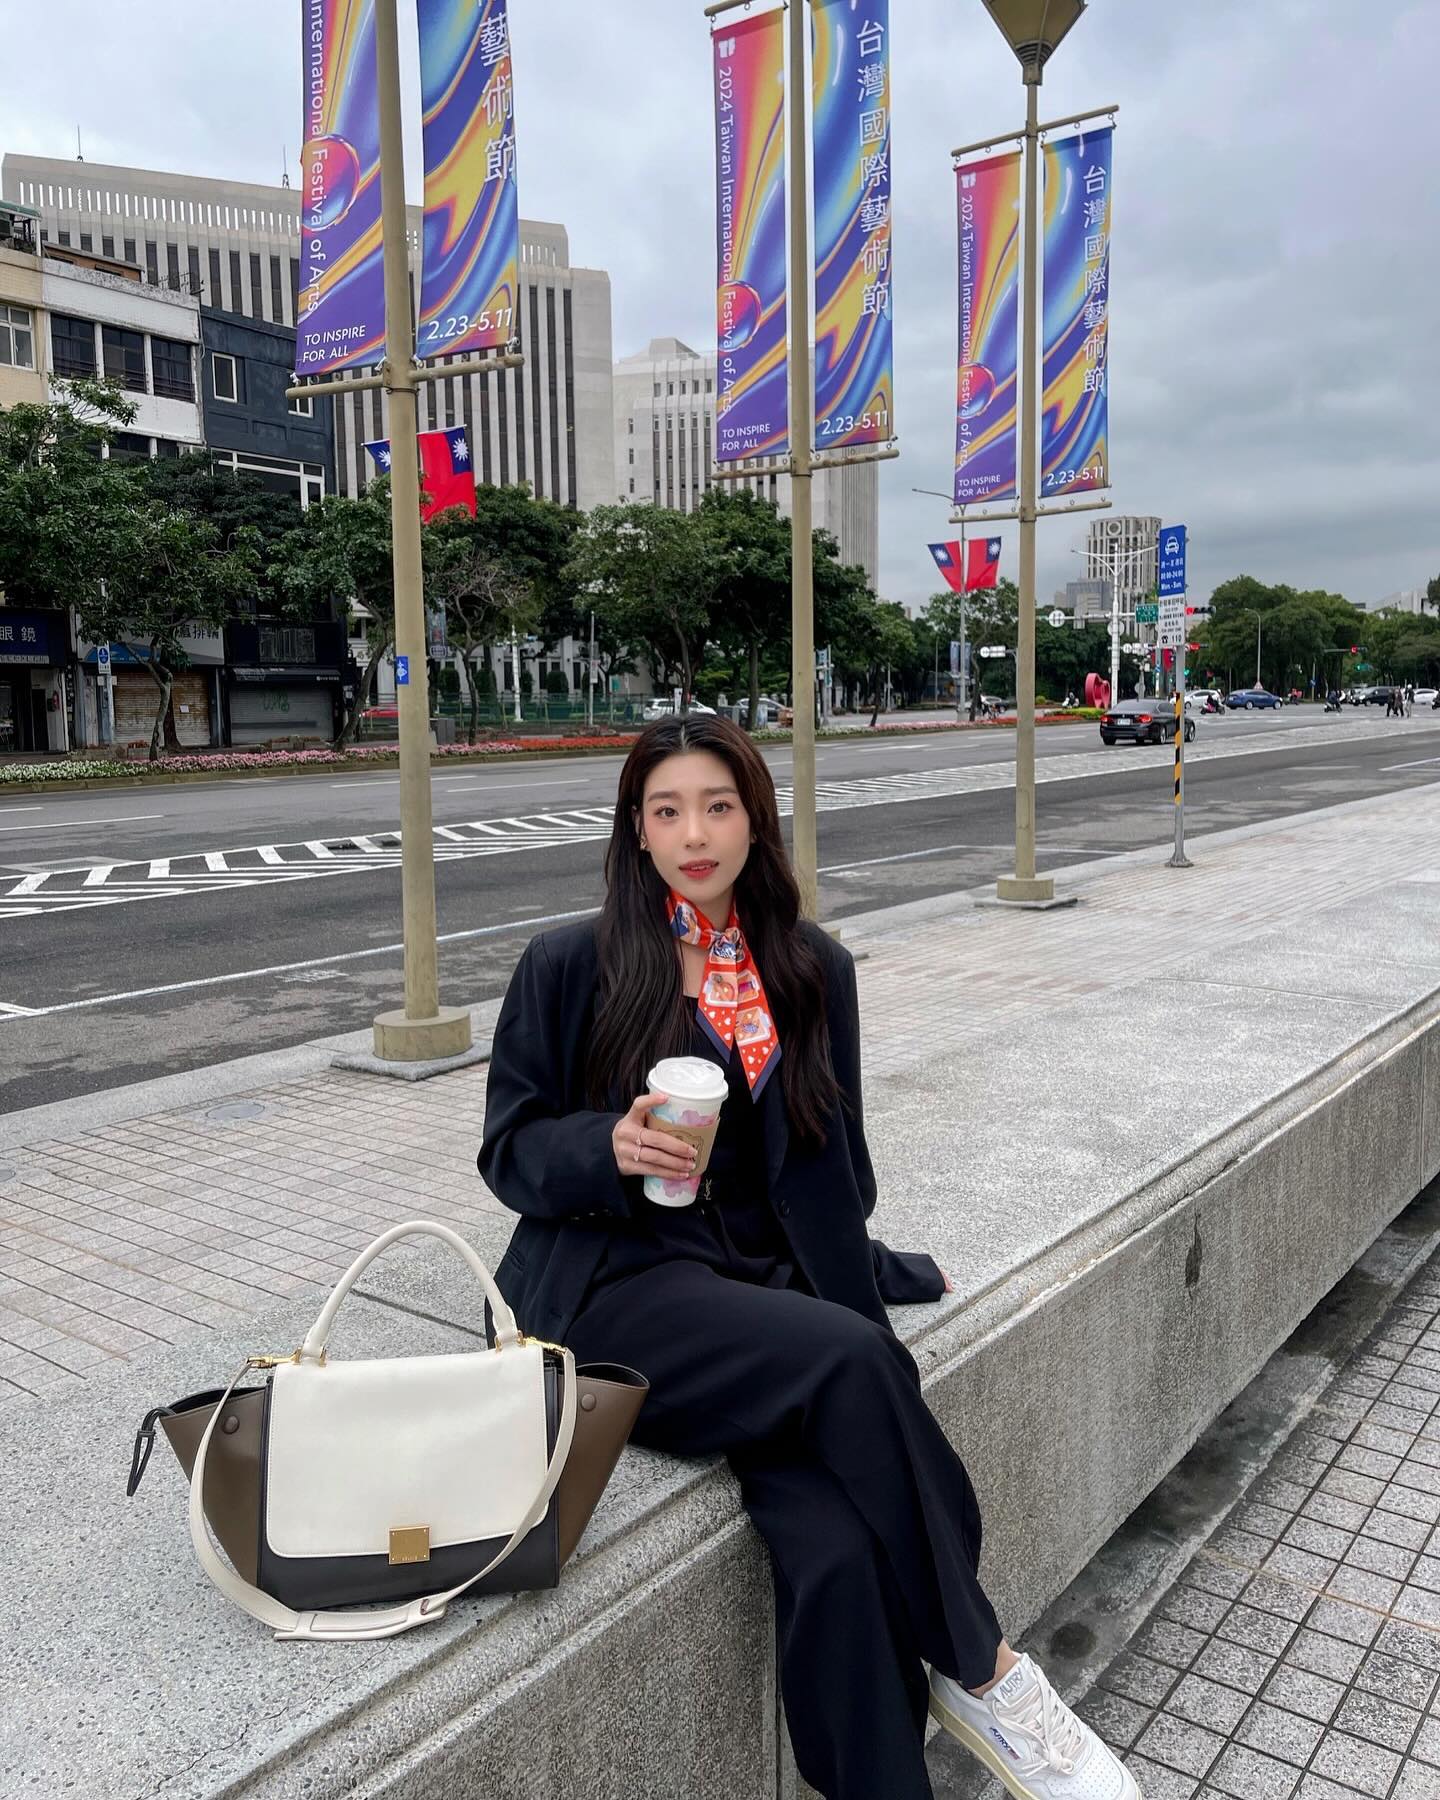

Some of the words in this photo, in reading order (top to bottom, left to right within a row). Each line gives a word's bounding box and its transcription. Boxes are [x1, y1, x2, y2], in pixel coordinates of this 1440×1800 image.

[478, 0, 516, 182] 藝術節
[719, 66, 733, 113] 2024
[721, 114, 734, 175] Taiwan
[856, 20, 889, 316] 台灣國際藝術節
[311, 148, 328, 231] Festival
[961, 195, 973, 231] 2024
[310, 239, 326, 260] of
[722, 179, 736, 286] International
[962, 232, 974, 280] Taiwan
[307, 266, 326, 312] Arts
[1082, 165, 1106, 394] 台灣國際藝術節
[304, 333, 321, 346] TO
[323, 325, 366, 344] INSPIRE
[426, 307, 512, 340] 2.23-5.11
[723, 291, 736, 352] Festival
[962, 282, 974, 367] International
[302, 350, 325, 363] FOR
[329, 345, 349, 359] ALL
[723, 358, 736, 374] of
[722, 378, 735, 413] Arts
[961, 371, 974, 419] Festival
[722, 428, 736, 438] TO
[737, 423, 771, 437] INSPIRE
[821, 410, 888, 435] 2.23-5.11
[960, 423, 972, 436] of
[722, 441, 740, 452] FOR
[743, 438, 759, 449] ALL
[958, 488, 974, 497] FOR
[977, 486, 990, 496] ALL
[959, 479, 970, 487] TO
[971, 474, 1001, 486] INSPIRE
[1046, 466, 1104, 486] 2.23-5.11
[1172, 635, 1182, 643] 110
[999, 1666, 1024, 1700] AUTRY
